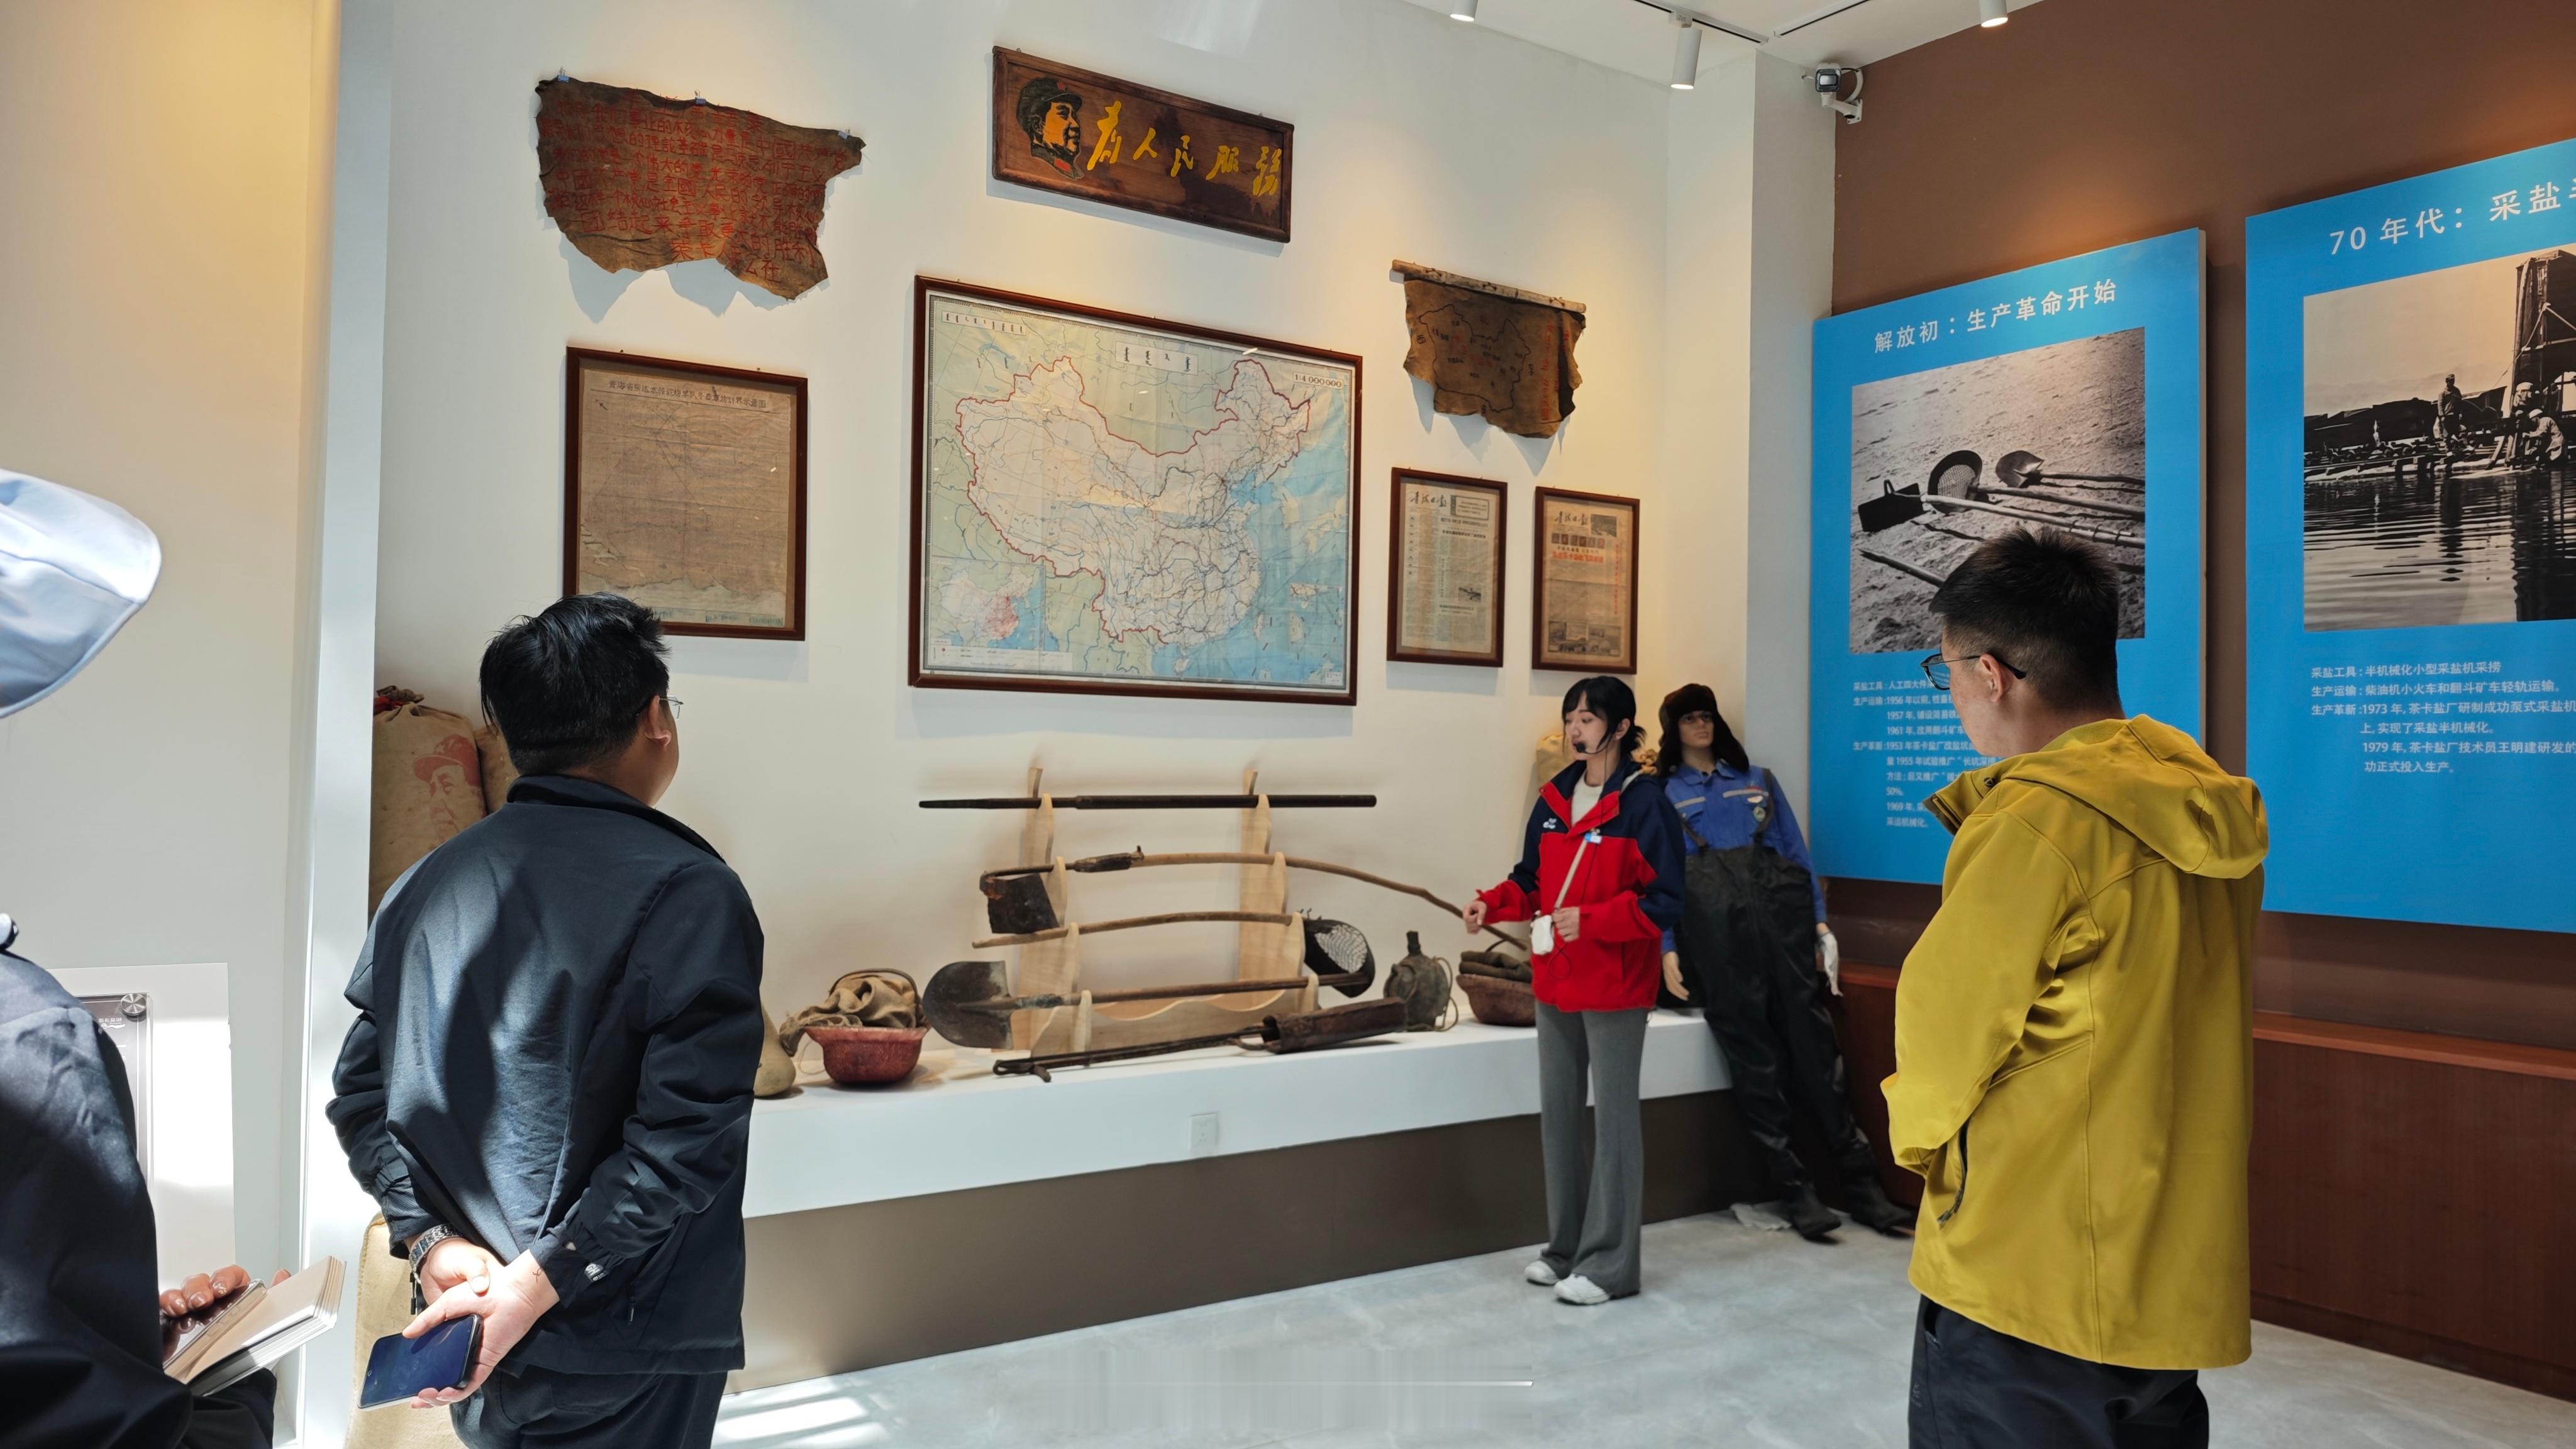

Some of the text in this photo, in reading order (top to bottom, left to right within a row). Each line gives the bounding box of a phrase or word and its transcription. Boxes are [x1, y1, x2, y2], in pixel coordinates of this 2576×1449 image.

[1874, 279, 2117, 353] 解放初：生产革命开始
